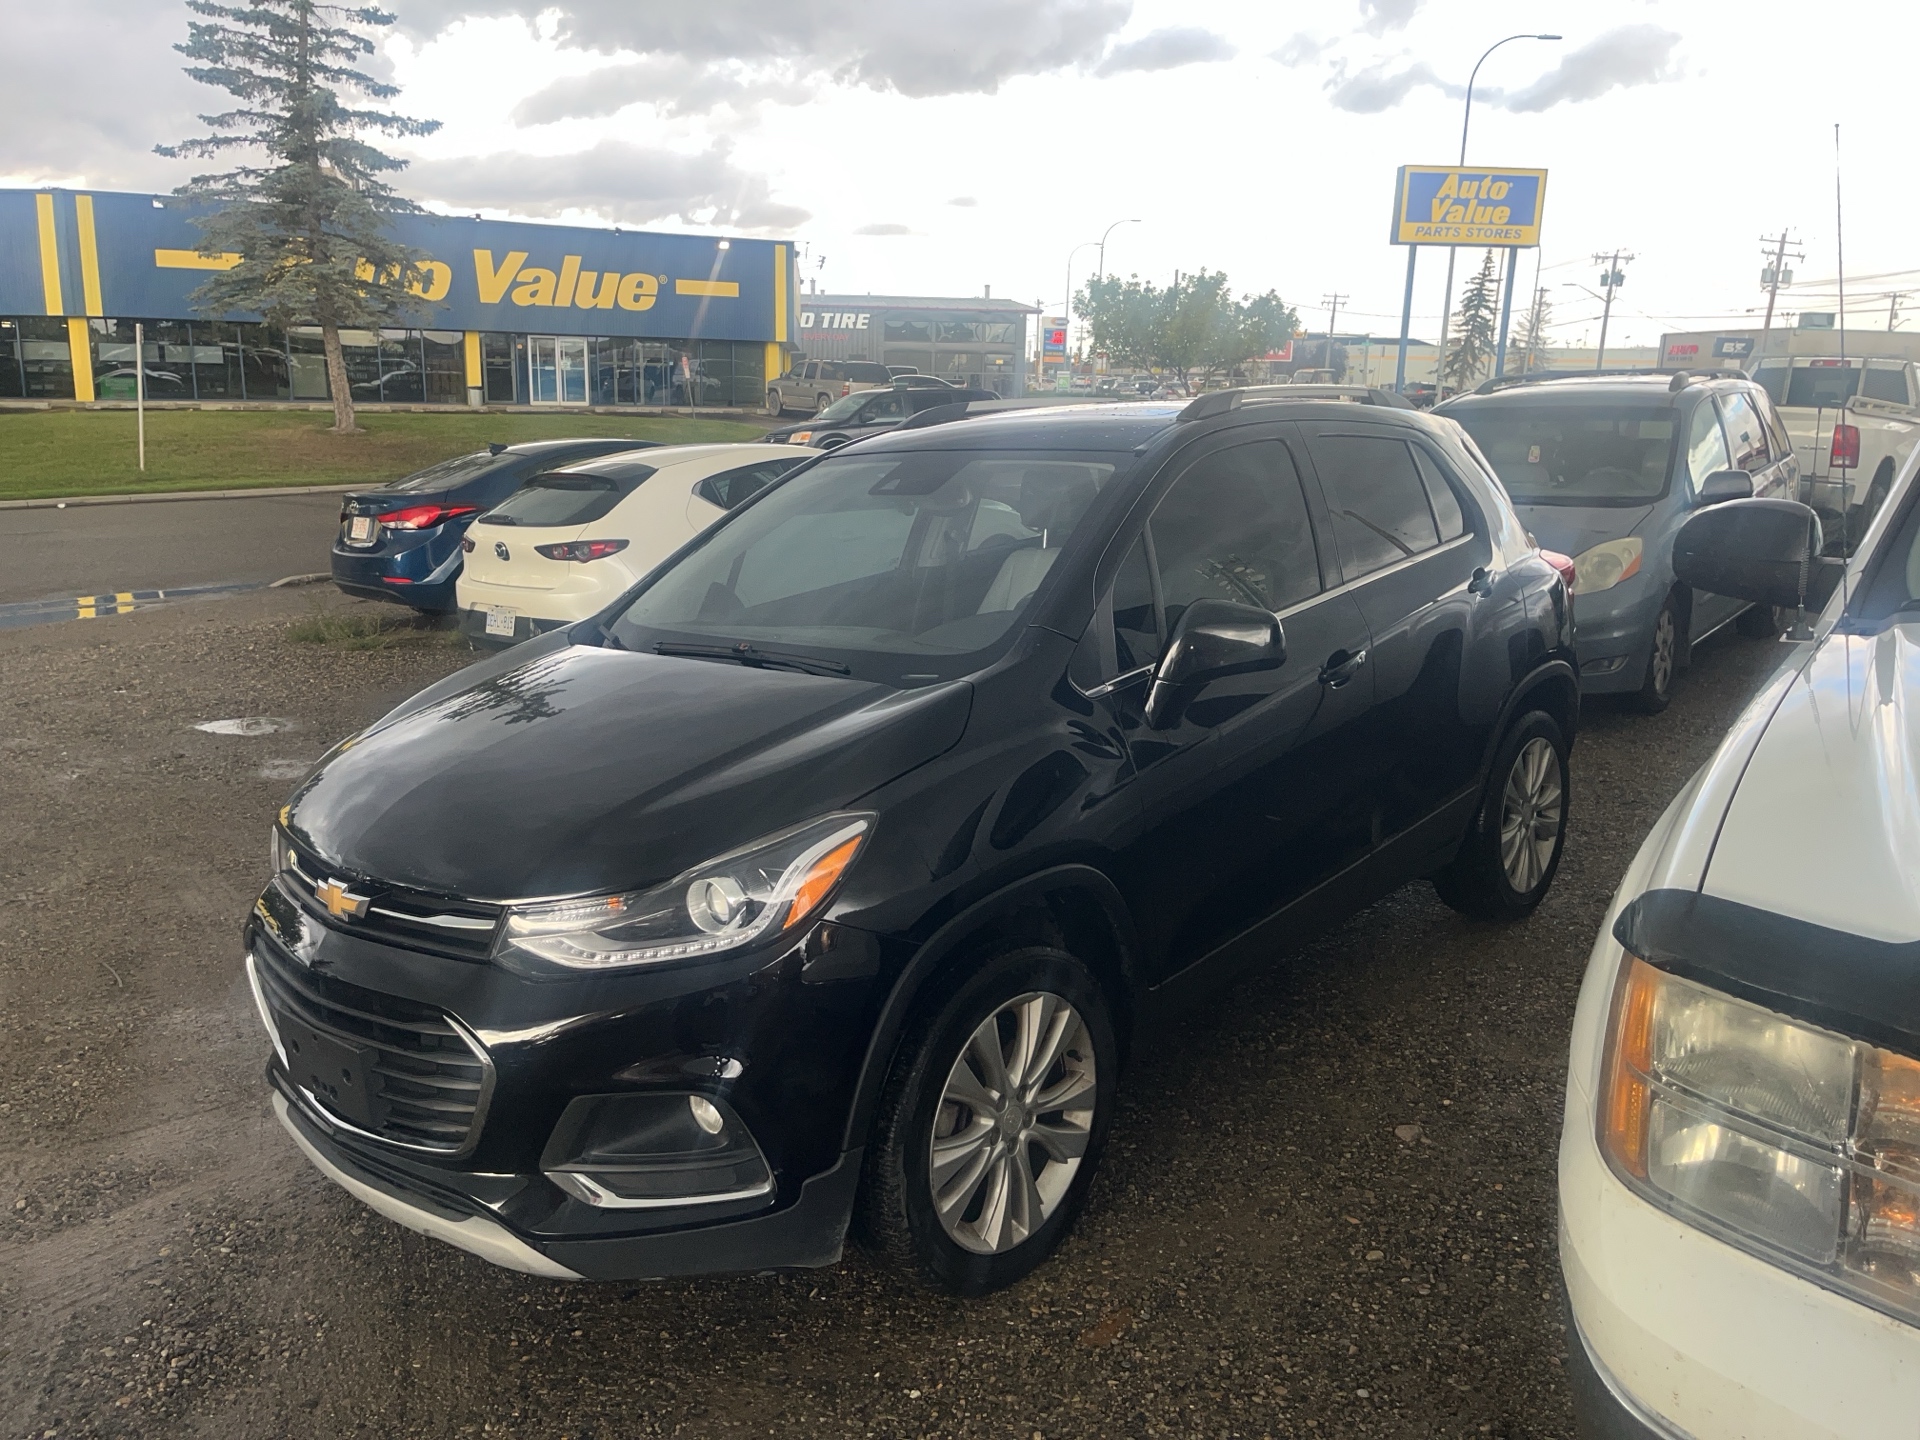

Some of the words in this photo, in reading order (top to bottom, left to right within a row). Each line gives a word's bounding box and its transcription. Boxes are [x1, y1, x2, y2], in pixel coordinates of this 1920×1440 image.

[1436, 174, 1509, 200] Auto
[1431, 198, 1511, 225] Value
[1414, 226, 1461, 238] PARTS
[1466, 227, 1522, 239] STORES
[821, 312, 871, 330] TIRE
